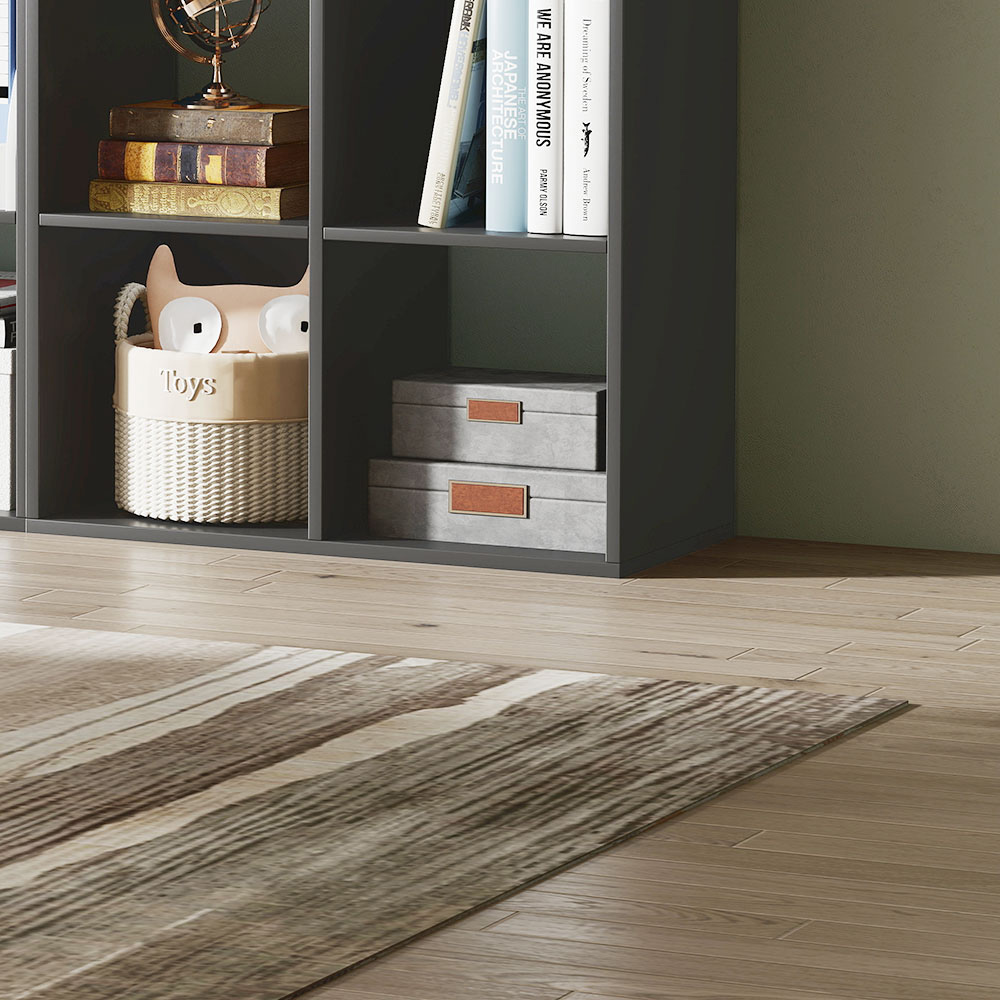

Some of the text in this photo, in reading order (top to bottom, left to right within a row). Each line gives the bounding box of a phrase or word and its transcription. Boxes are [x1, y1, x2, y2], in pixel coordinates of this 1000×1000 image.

[503, 50, 518, 140] JAPANESE
[536, 8, 552, 147] WE ARE ANONYMOUS
[580, 19, 592, 112] Dreaming of Sweden
[491, 49, 504, 185] ARCHITECTURE
[518, 88, 526, 141] THE ART OF
[539, 169, 548, 216] PARMY OLSON
[582, 168, 591, 222] Andrew Brown
[160, 368, 217, 402] Toys
